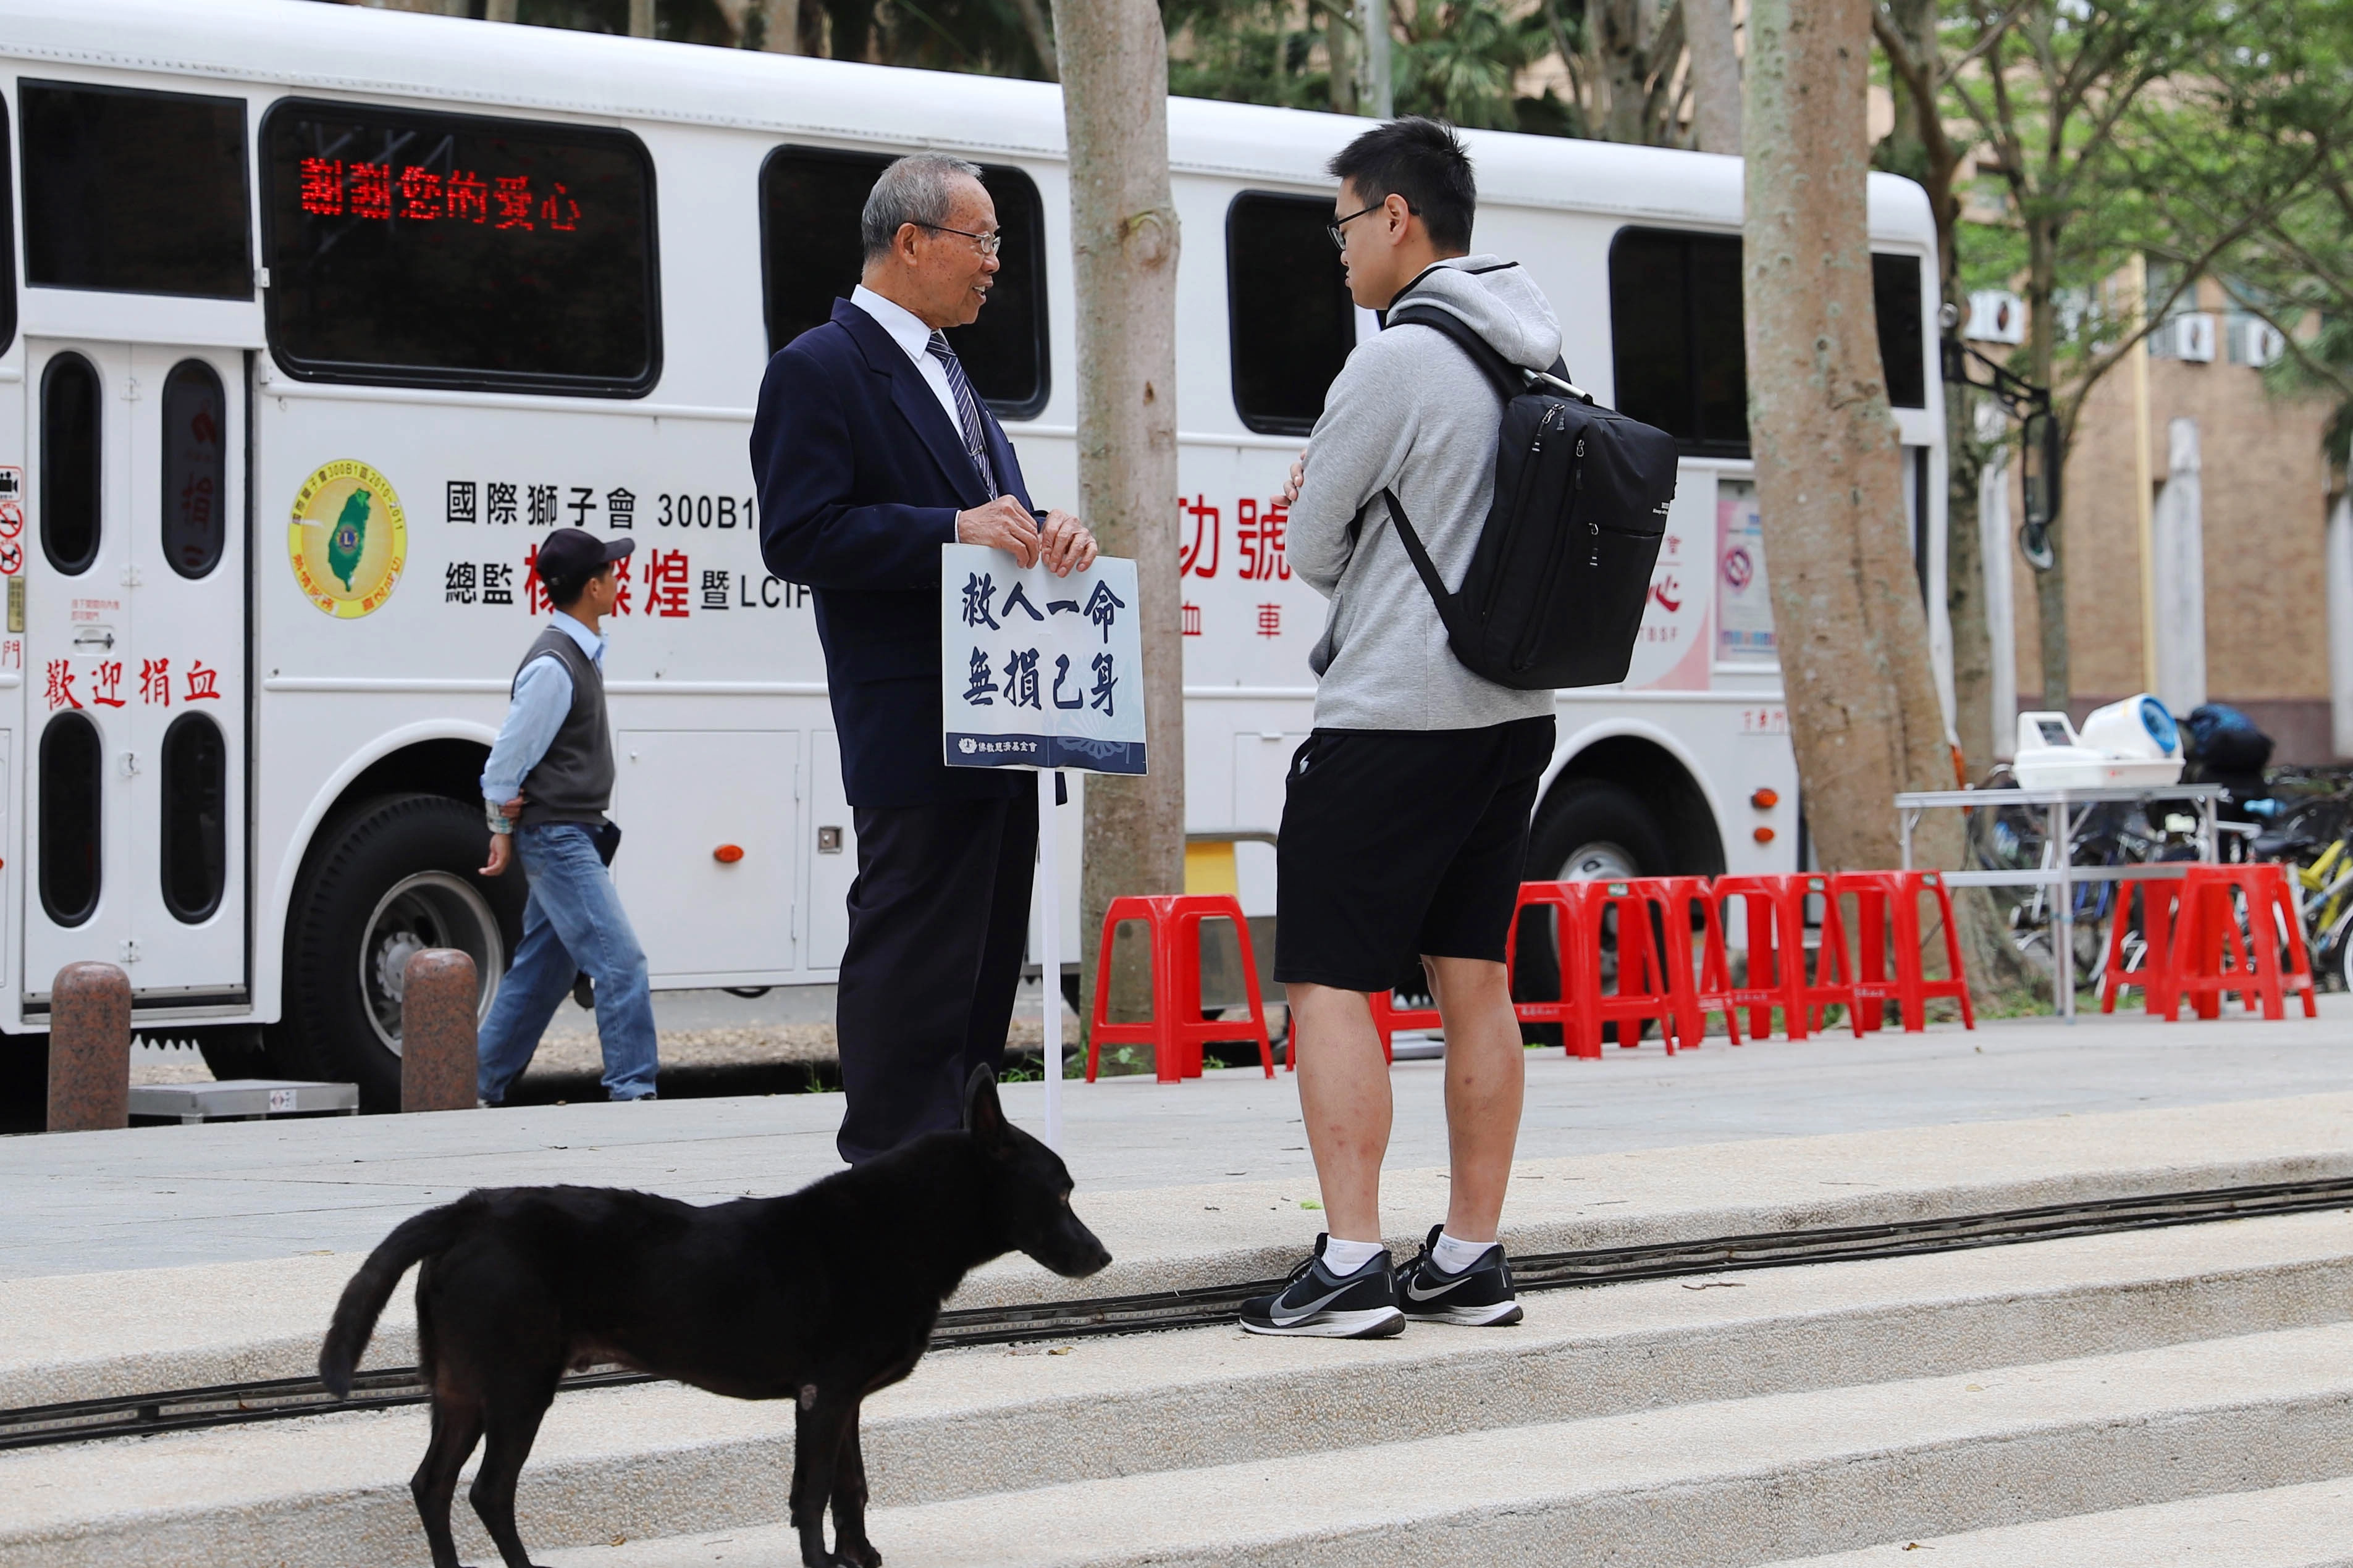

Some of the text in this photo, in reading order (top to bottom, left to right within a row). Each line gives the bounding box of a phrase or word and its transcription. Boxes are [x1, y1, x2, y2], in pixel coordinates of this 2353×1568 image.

[300, 157, 581, 231] 謝謝您的愛心
[447, 480, 753, 529] 國際獅子會 300B1
[962, 572, 1126, 644] 救人一命
[2, 640, 20, 669] 門
[43, 658, 221, 711] 歡迎捐血
[962, 646, 1119, 716] 無損己身
